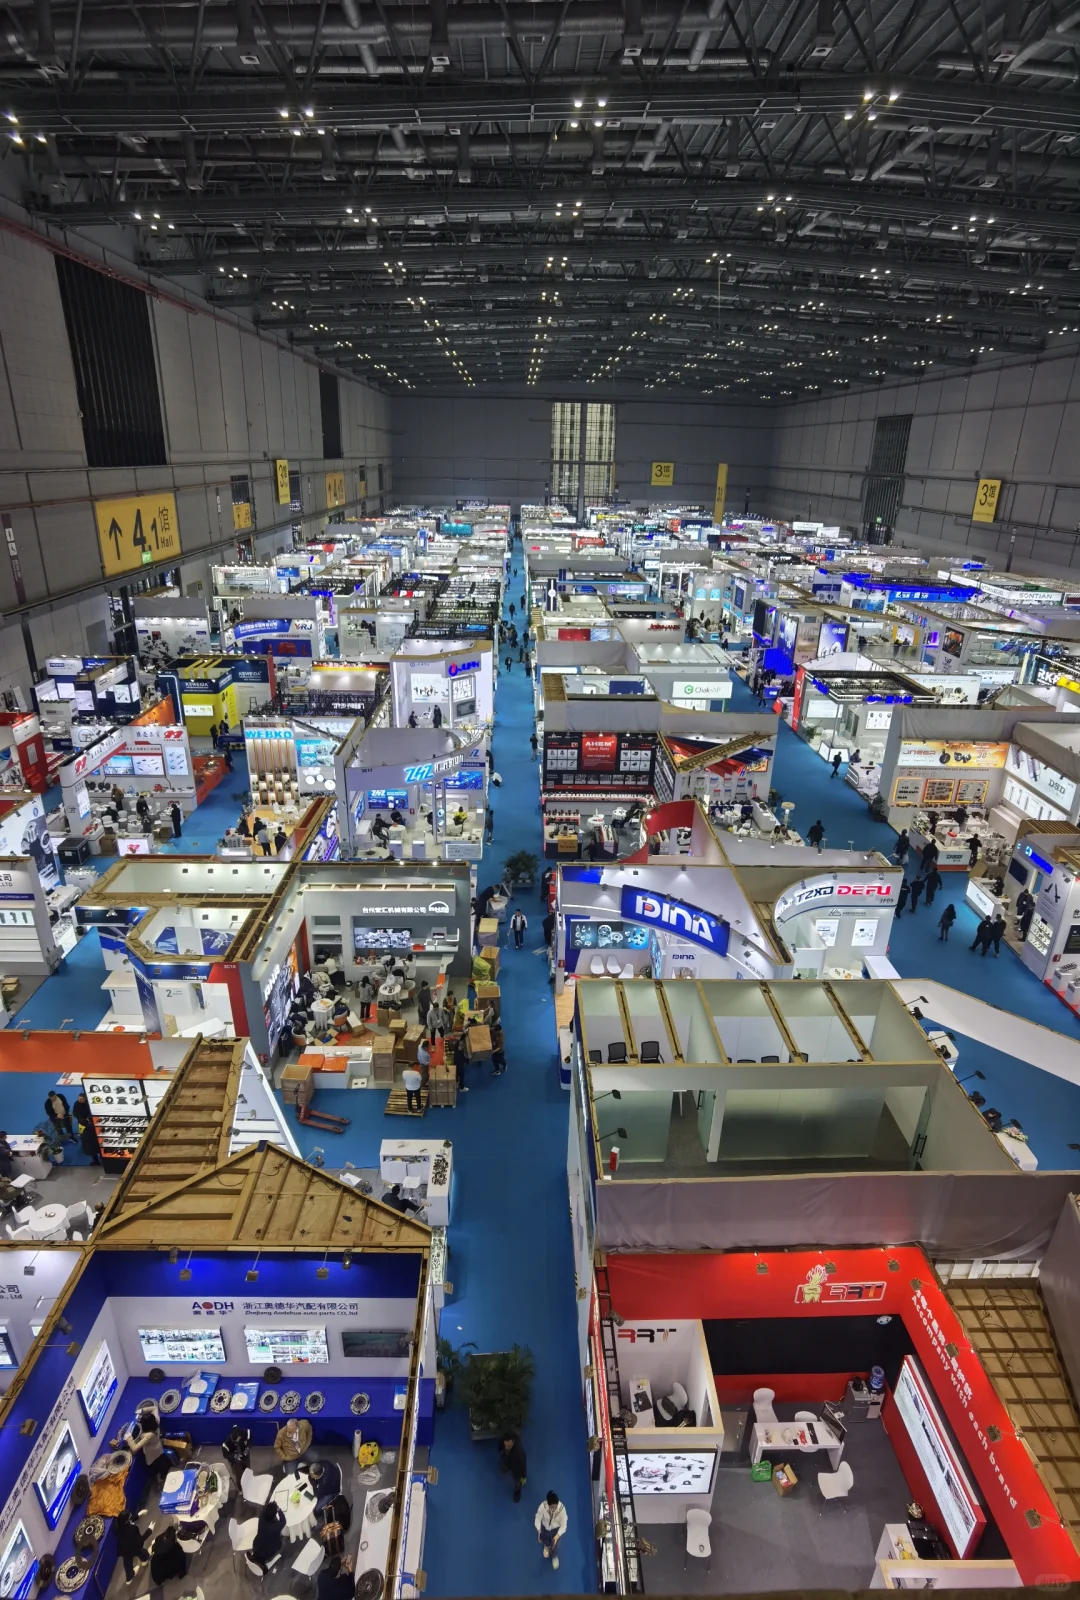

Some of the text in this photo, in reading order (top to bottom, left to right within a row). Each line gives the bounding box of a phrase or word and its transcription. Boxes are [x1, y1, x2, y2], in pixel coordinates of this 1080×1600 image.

[655, 465, 663, 478] 3
[980, 484, 989, 506] 3
[133, 507, 171, 553] 4.1 馆
[160, 535, 174, 549] Hall
[245, 731, 293, 739] WEBKO
[1048, 779, 1066, 795] DSD
[837, 885, 892, 896] DEFU
[635, 894, 714, 943] DINA
[111, 989, 117, 997] 1
[166, 989, 172, 998] 2
[191, 1301, 235, 1310] AODH
[242, 1302, 359, 1311] 浙江奥德华汽配有限公司
[911, 1295, 1018, 1509] Accompany with each brand
